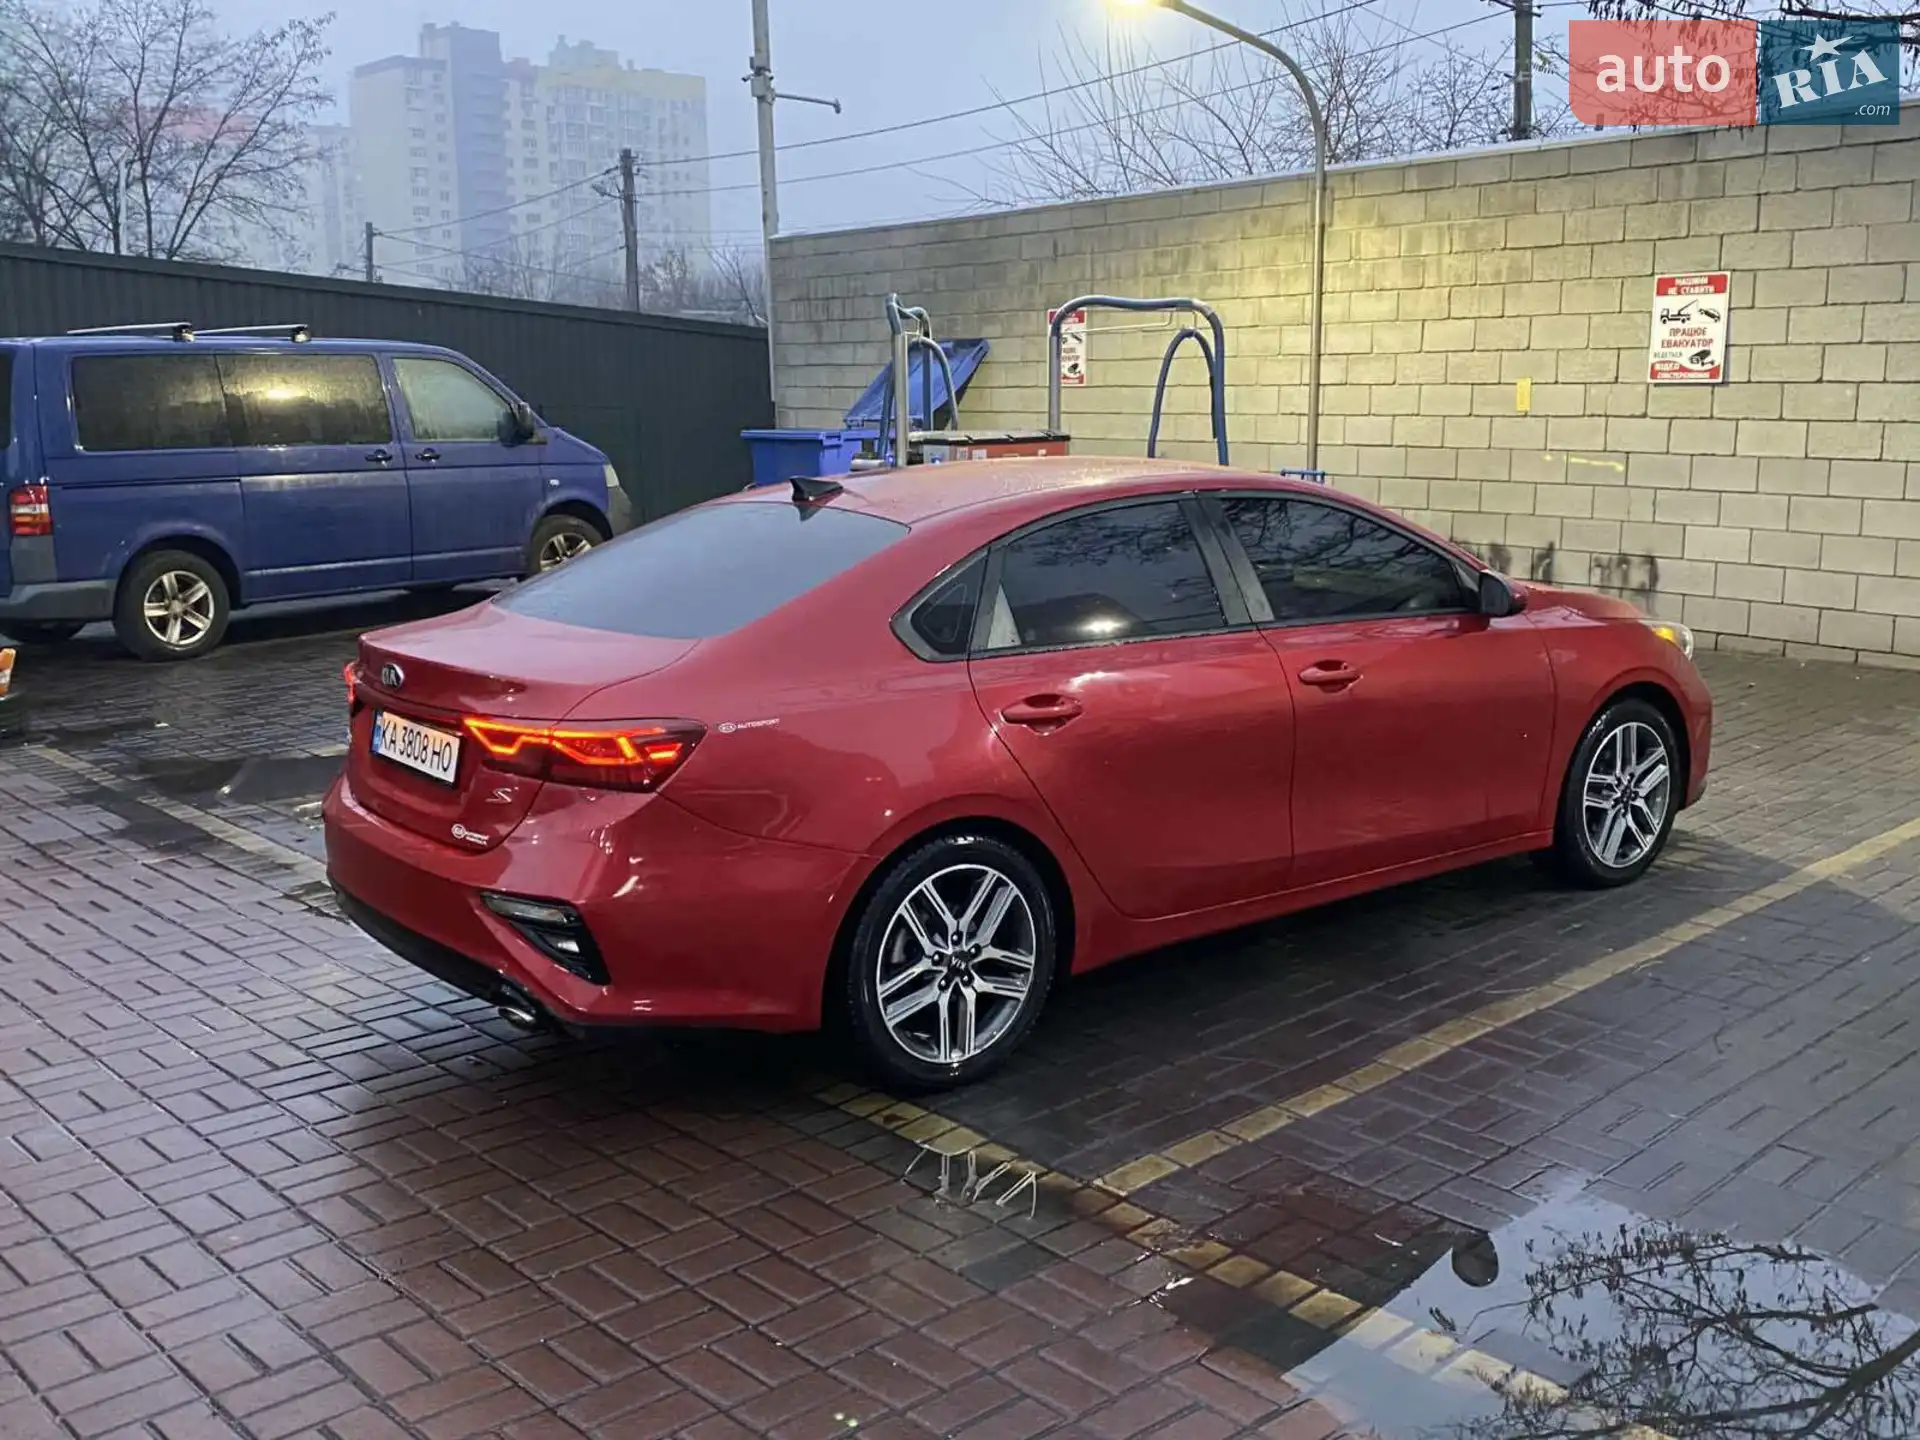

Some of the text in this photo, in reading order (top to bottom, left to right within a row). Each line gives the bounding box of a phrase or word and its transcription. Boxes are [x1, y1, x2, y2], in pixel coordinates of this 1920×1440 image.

[1669, 327, 1708, 337] ПРАЦЮЄ
[1661, 338, 1714, 349] ЕВАКУАТОР
[382, 720, 452, 772] KA 3808 HO
